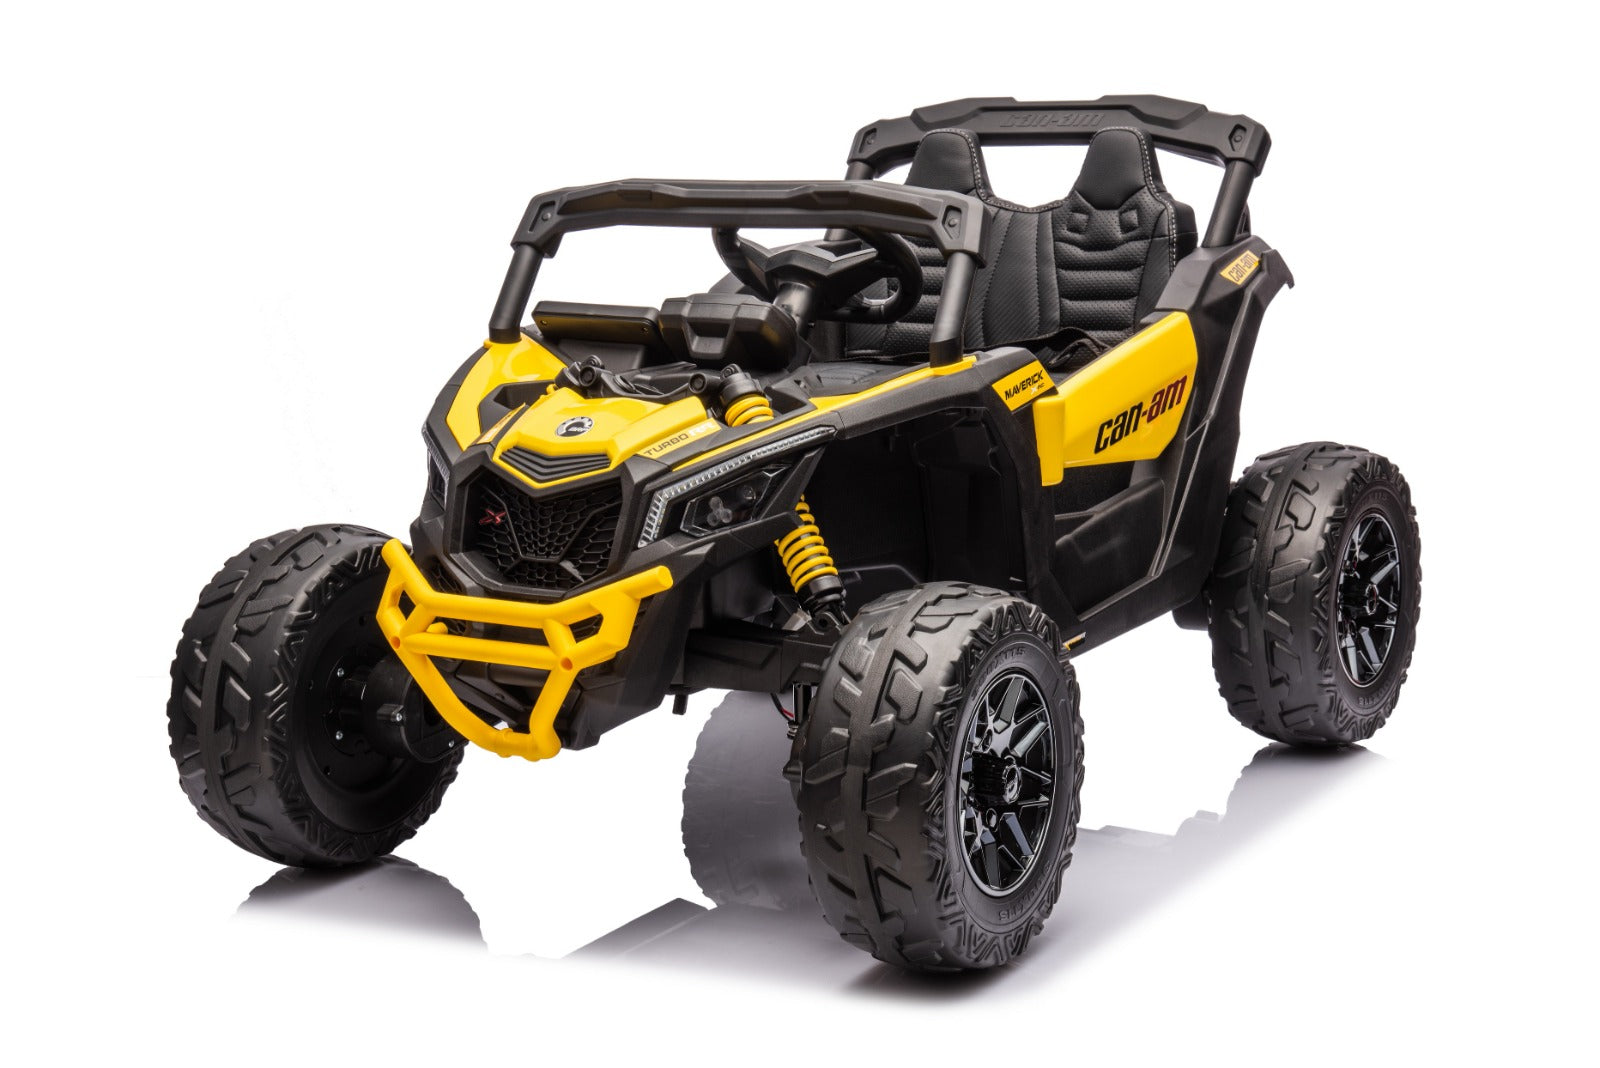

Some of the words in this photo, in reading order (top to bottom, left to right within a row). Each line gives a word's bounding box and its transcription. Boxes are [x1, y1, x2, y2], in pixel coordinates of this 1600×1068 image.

[1228, 252, 1258, 283] can-am
[1004, 369, 1044, 401] MAVERICK
[1094, 375, 1188, 454] can-am
[643, 433, 689, 456] TURBO
